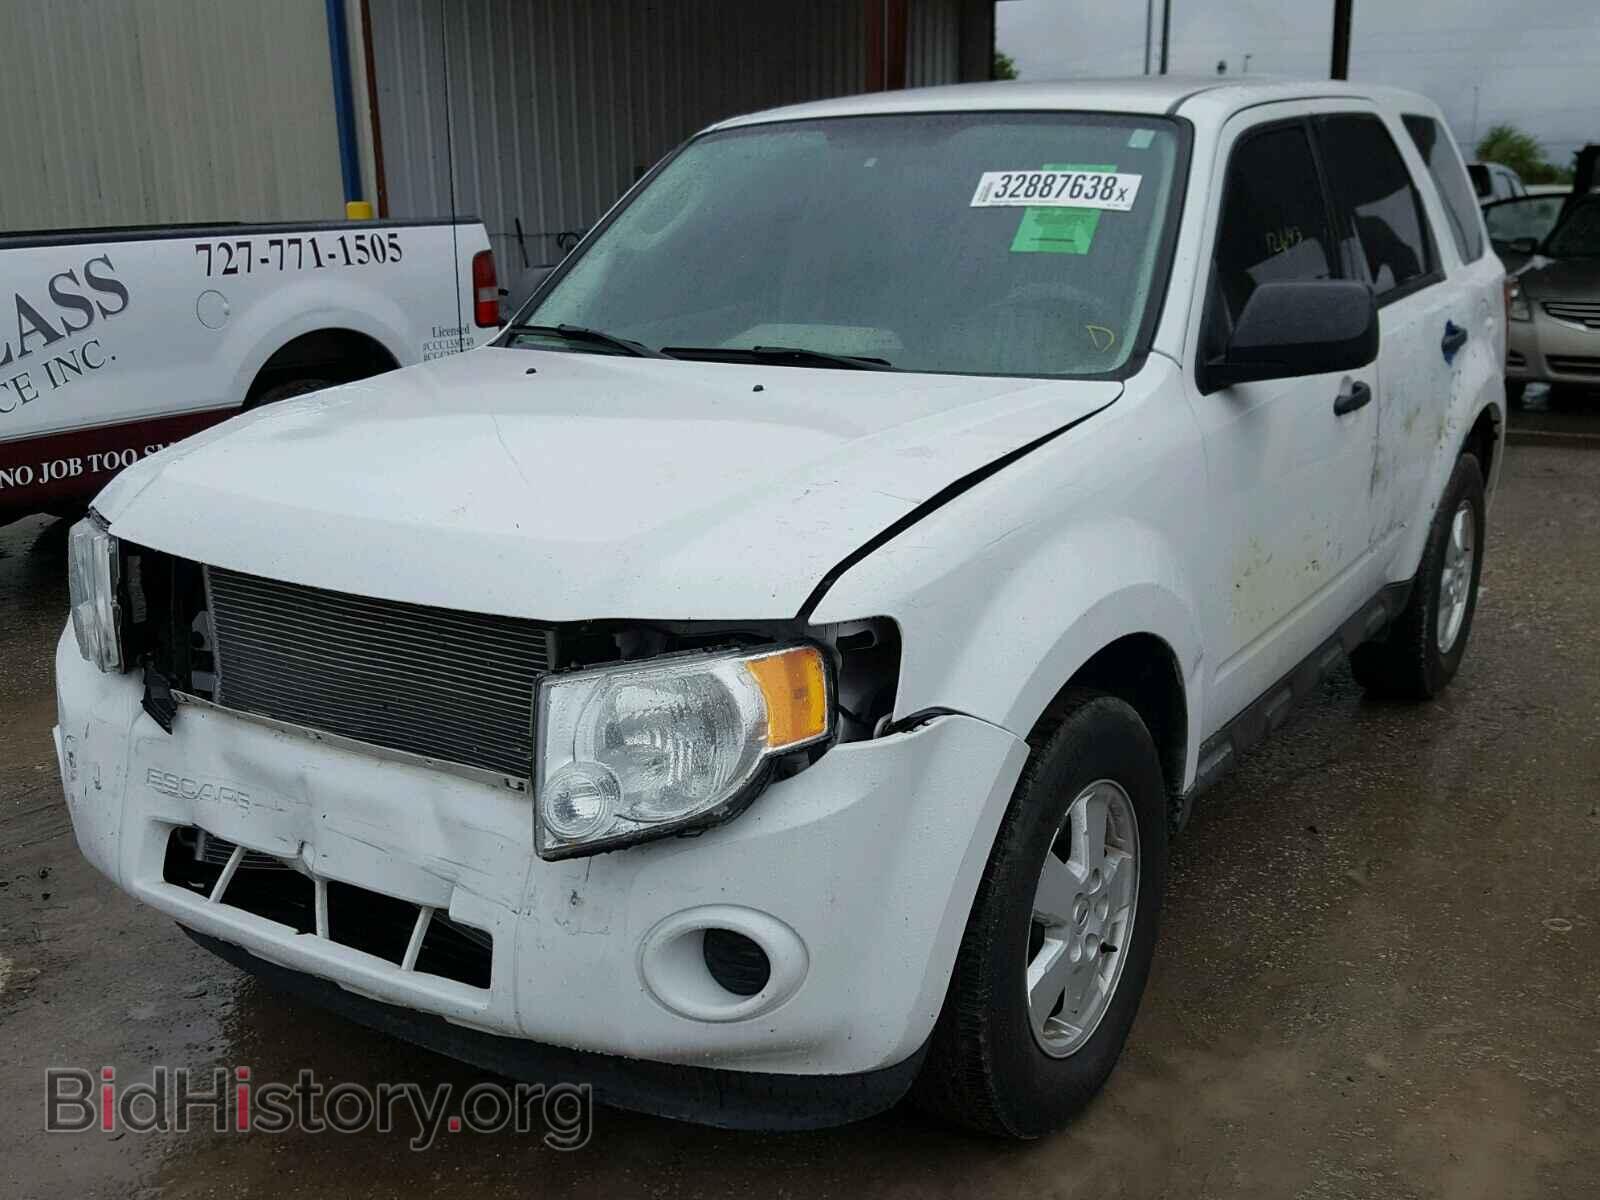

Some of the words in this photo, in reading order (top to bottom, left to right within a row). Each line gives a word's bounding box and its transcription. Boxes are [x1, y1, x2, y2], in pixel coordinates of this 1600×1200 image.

[195, 232, 403, 277] 727-771-1505
[42, 340, 116, 390] INC.
[0, 465, 33, 489] NO
[38, 457, 83, 485] JOB
[87, 448, 138, 473] TOO
